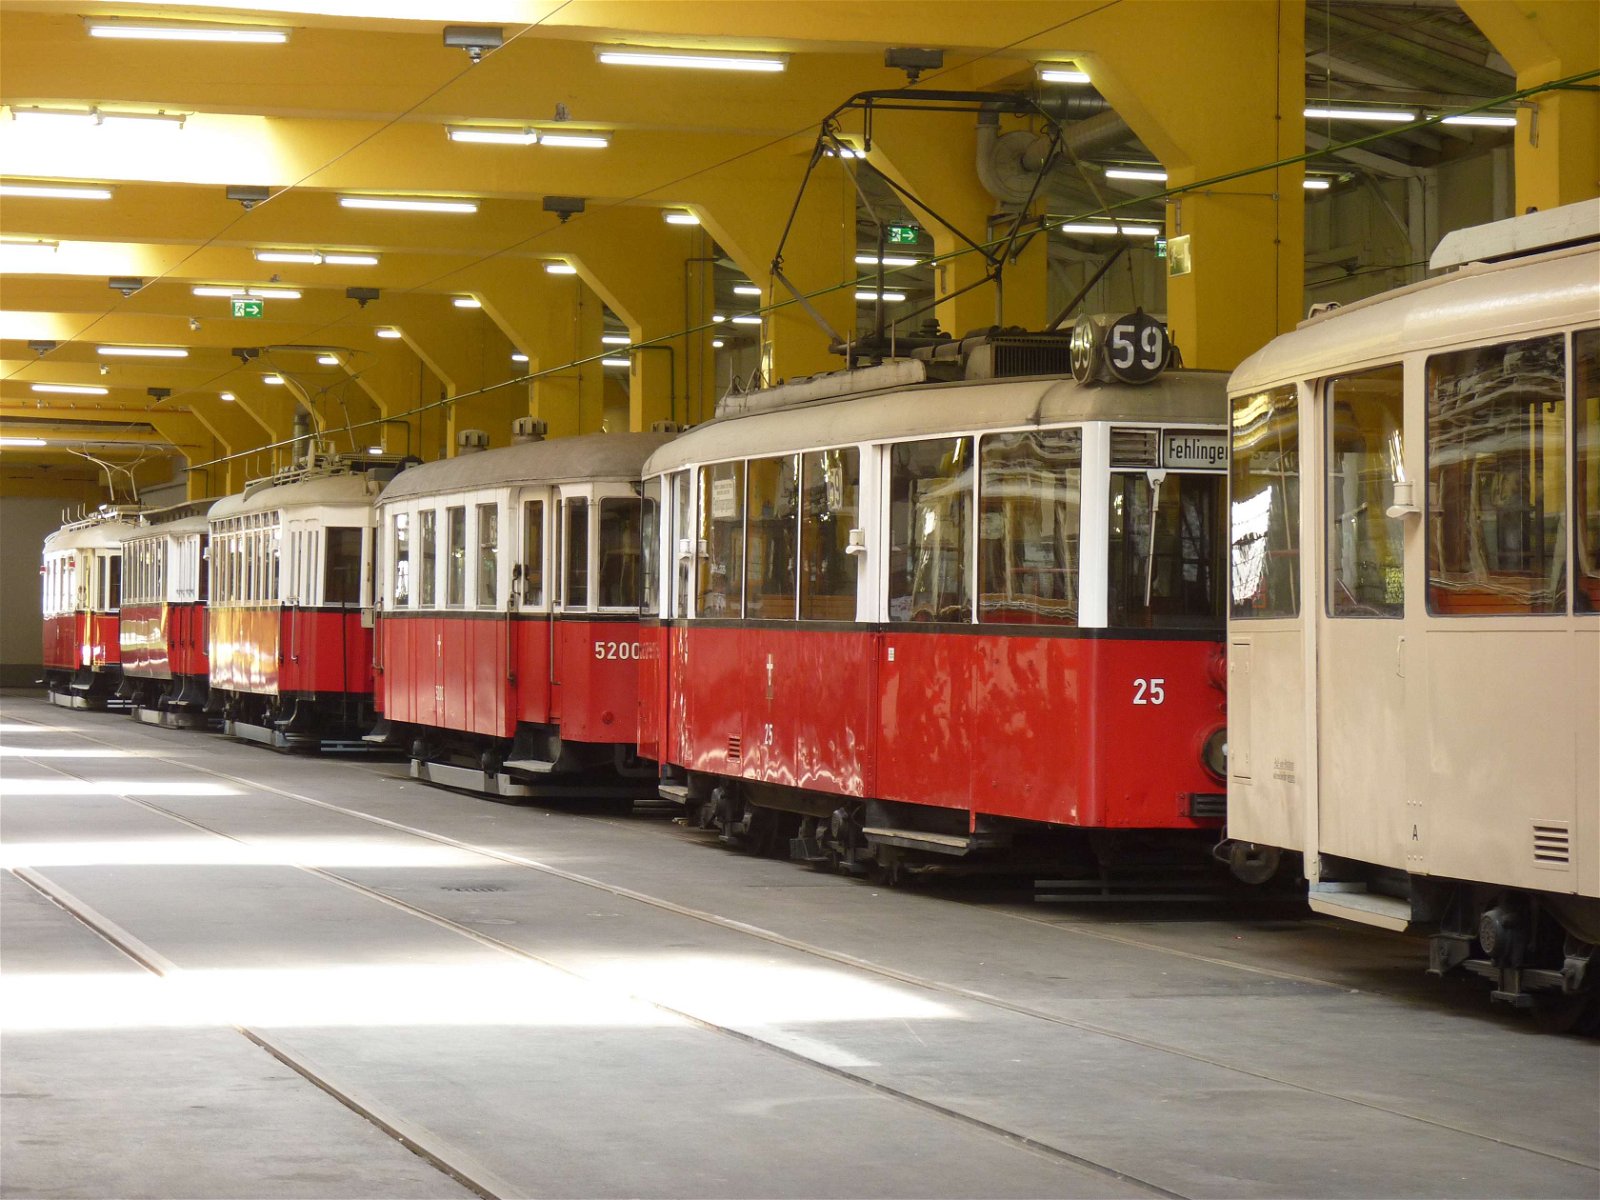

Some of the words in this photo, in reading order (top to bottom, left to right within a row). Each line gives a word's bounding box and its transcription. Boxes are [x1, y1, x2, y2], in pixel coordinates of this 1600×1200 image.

[1113, 325, 1164, 370] 59
[1132, 678, 1165, 705] 25
[764, 723, 773, 746] 25
[1412, 824, 1419, 841] A
